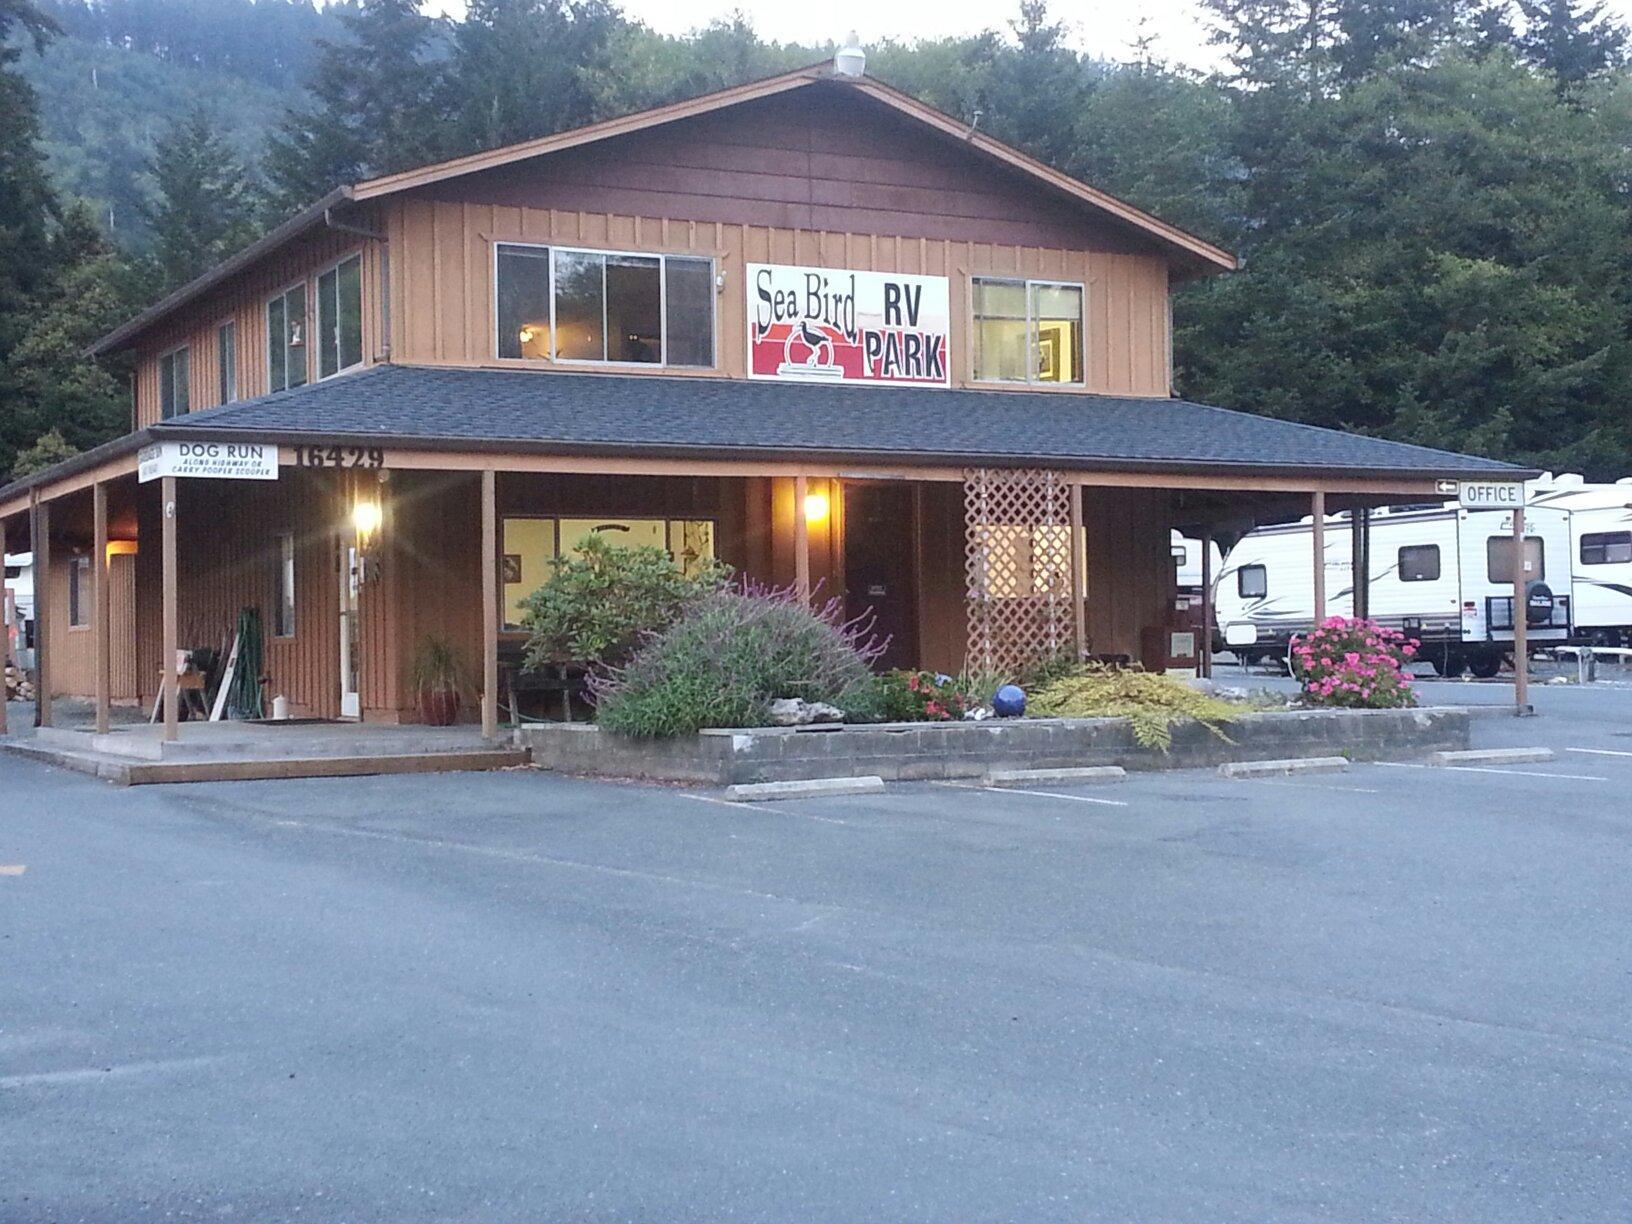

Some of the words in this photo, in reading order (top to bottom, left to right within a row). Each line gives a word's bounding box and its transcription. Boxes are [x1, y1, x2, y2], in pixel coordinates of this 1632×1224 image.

[757, 269, 799, 335] Sea
[804, 273, 858, 344] Bird
[884, 282, 922, 327] RV
[864, 331, 943, 378] PARK
[179, 443, 219, 457] DOG
[227, 445, 263, 459] RUN
[293, 444, 384, 468] 16429
[1467, 486, 1516, 502] OFFICE
